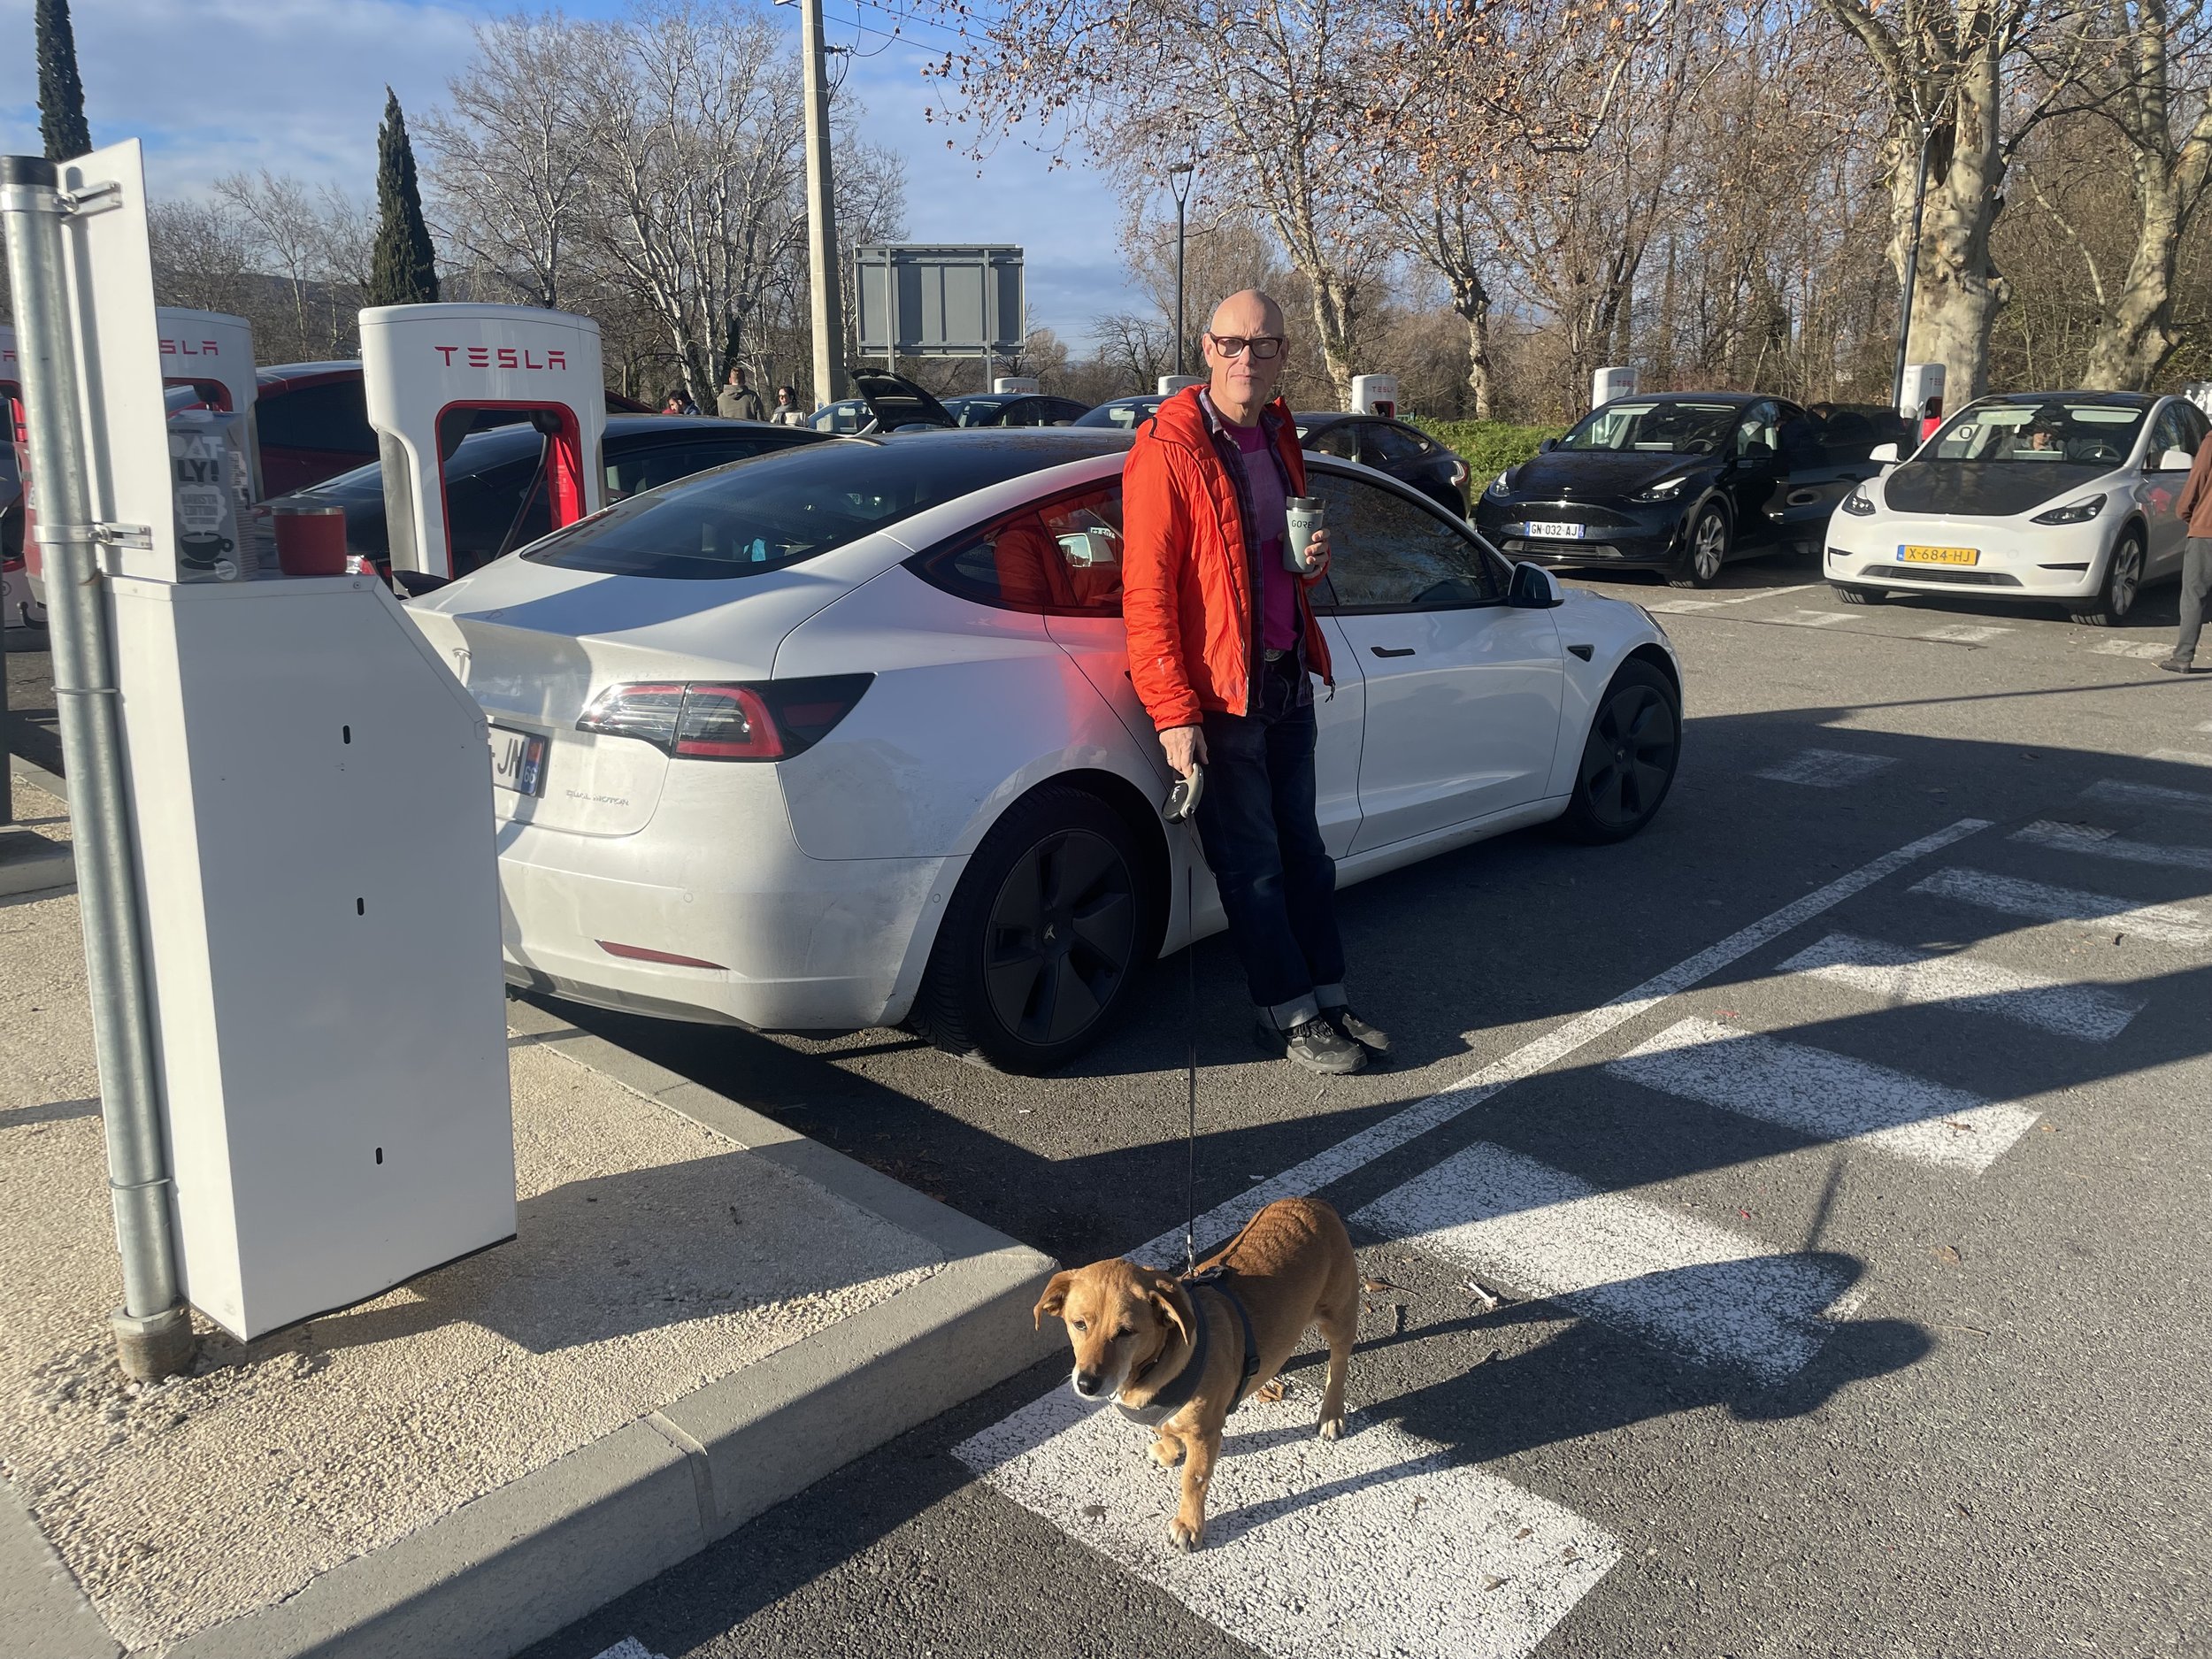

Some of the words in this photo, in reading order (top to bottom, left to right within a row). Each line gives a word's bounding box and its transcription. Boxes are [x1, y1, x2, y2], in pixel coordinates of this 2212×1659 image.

[160, 340, 219, 356] SLA
[434, 346, 566, 371] TESLA
[524, 765, 537, 786] 66
